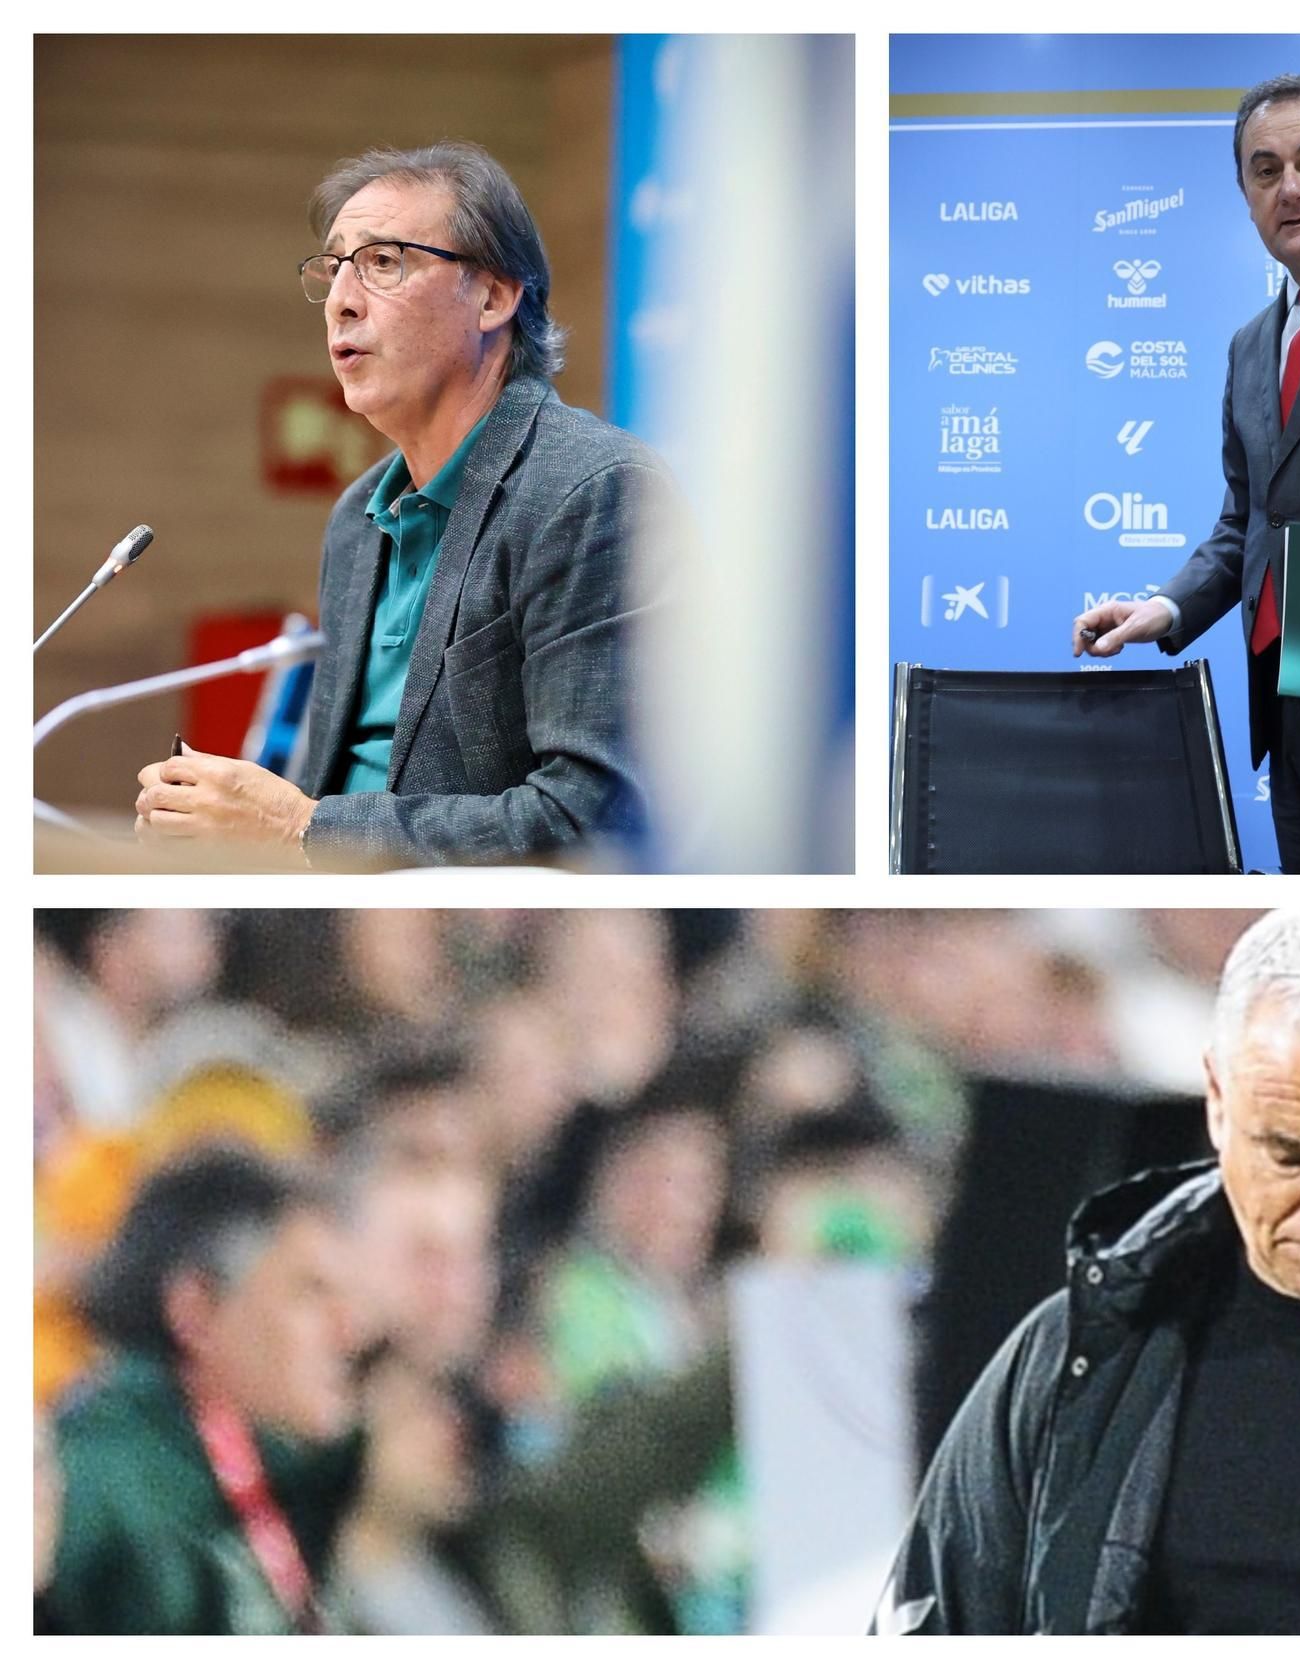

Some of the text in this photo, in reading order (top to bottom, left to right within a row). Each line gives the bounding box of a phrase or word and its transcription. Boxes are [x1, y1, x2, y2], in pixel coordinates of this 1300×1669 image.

[940, 201, 1019, 221] LALIGA
[955, 274, 1031, 295] vithas
[1107, 293, 1167, 309] hummel
[1130, 341, 1187, 354] COSTA
[949, 352, 1019, 363] DENTAL
[1130, 355, 1188, 367] DEL SOL
[949, 363, 1017, 375] CLINICS
[1130, 366, 1188, 379] MÁLAGA
[1083, 491, 1169, 531] Olin
[926, 507, 1010, 531] LALIGA
